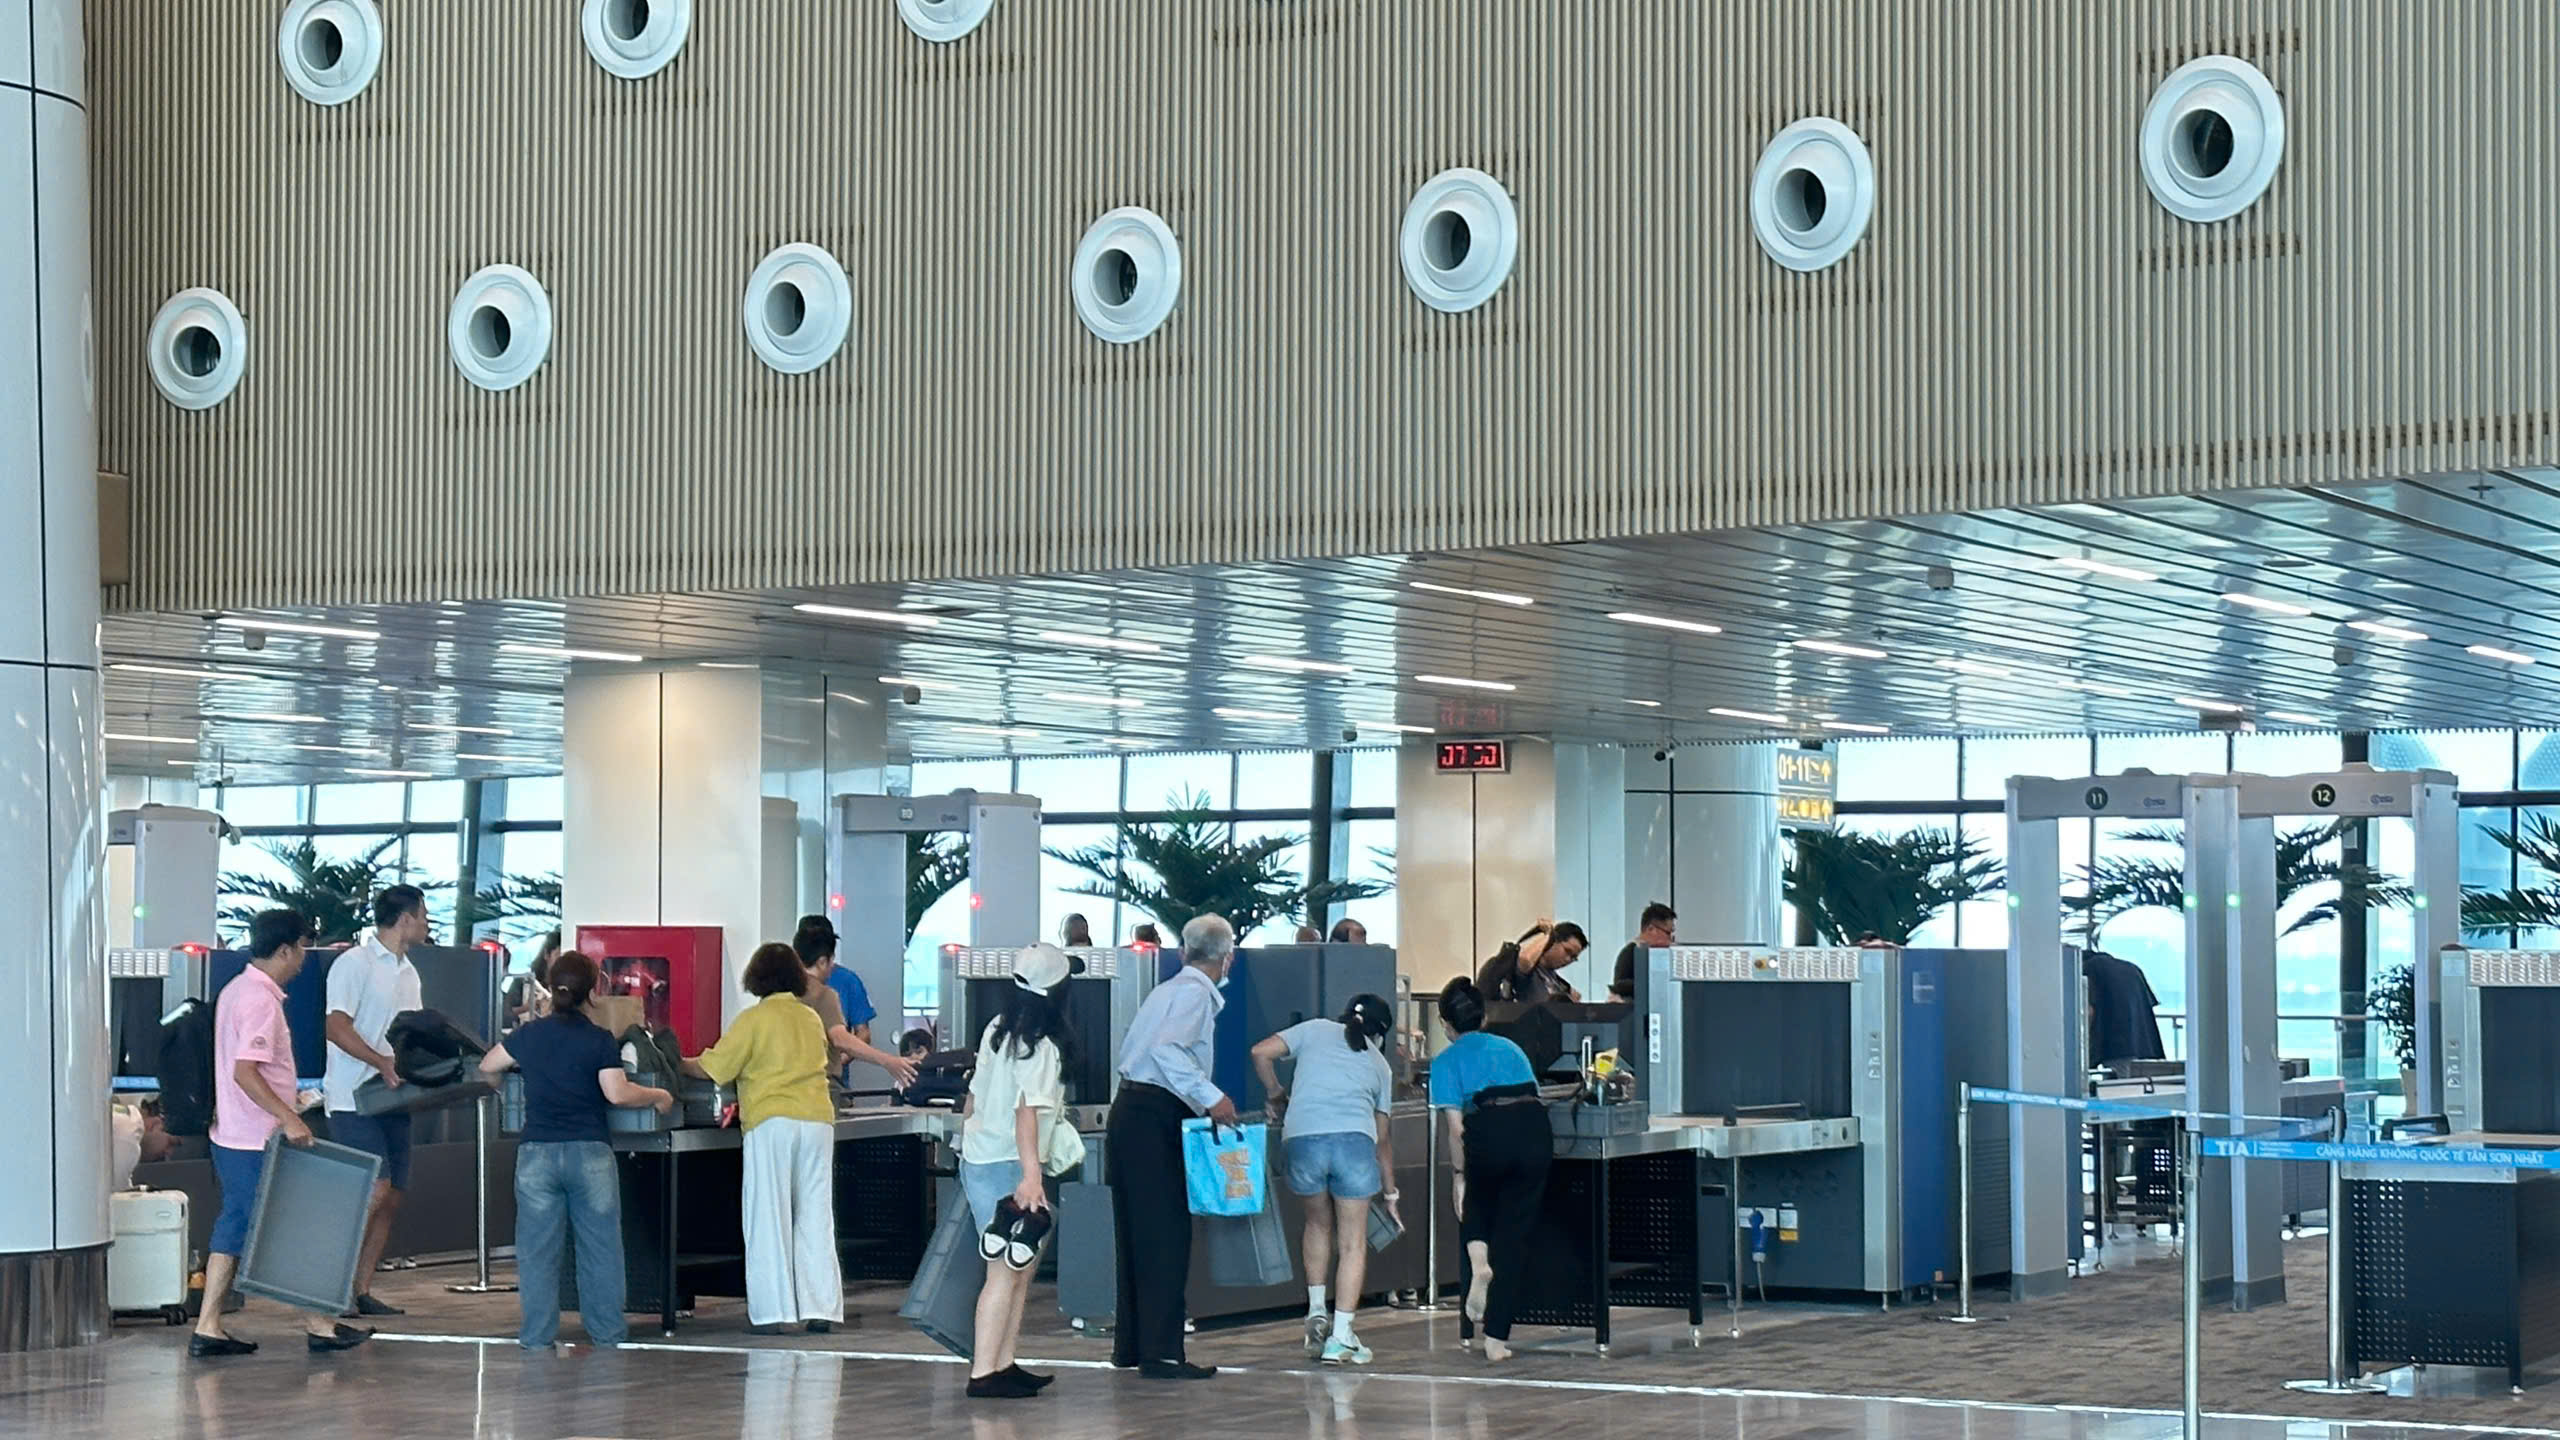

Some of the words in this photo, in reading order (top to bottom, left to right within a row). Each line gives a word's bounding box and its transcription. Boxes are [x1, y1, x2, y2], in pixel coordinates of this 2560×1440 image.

[2092, 793, 2103, 805] 11
[2316, 789, 2331, 802] 12
[2215, 1140, 2249, 1156] TIA
